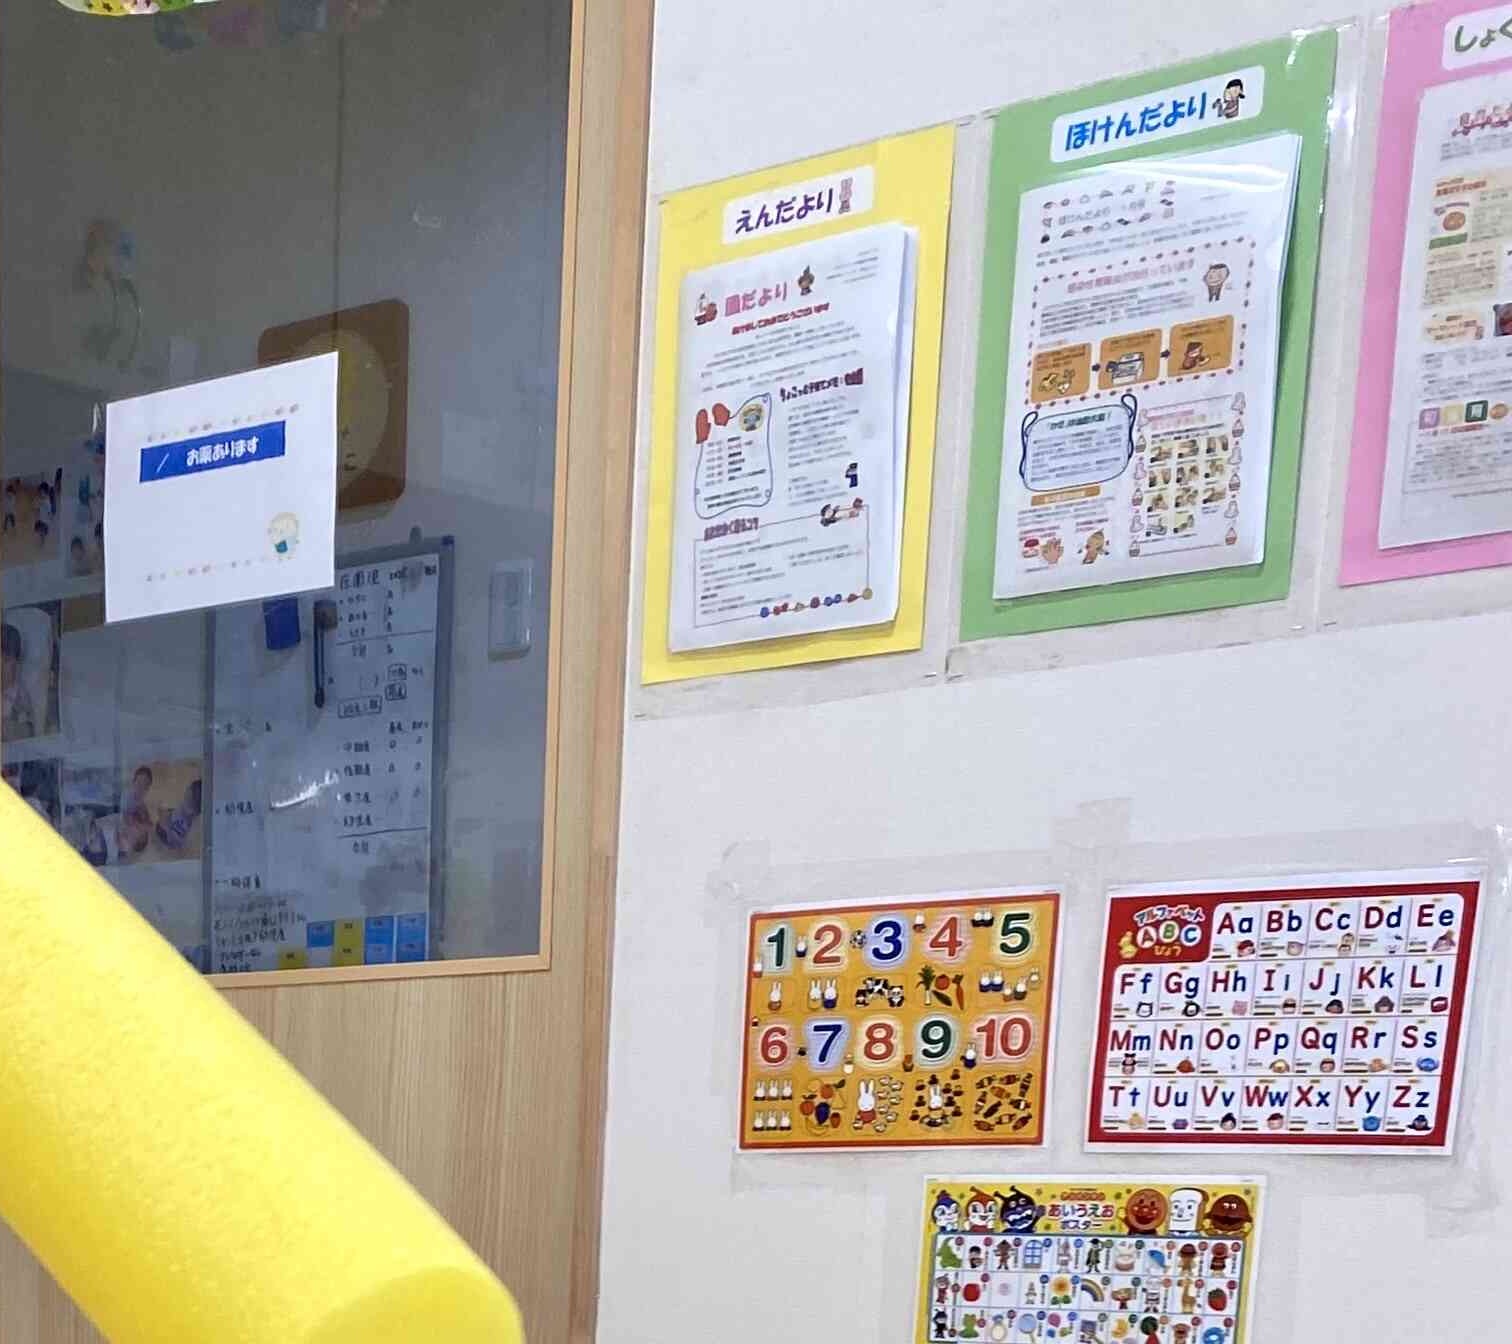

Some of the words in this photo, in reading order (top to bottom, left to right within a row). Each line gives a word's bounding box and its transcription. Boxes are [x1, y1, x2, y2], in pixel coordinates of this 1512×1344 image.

[1064, 91, 1208, 152] ほけんだより
[735, 187, 834, 235] えんだより
[1141, 921, 1198, 946] ABC
[1217, 912, 1253, 935] Aa
[1266, 909, 1302, 932] Bb
[1315, 907, 1351, 930] Cc
[1364, 905, 1402, 928] Dd
[1416, 903, 1454, 928] Ee
[766, 927, 786, 967] 1
[813, 925, 842, 964] 2
[872, 920, 902, 961] 3
[929, 917, 963, 957] 4
[999, 912, 1031, 954] 5
[1120, 973, 1153, 995] Ff
[1164, 972, 1200, 998] Gg
[1211, 970, 1247, 993] Hh
[1263, 969, 1290, 992] Ii
[1308, 968, 1340, 996] Jj
[1357, 966, 1394, 989] Kk
[1410, 965, 1443, 988] Ll
[760, 1026, 788, 1064] 6
[813, 1024, 842, 1063] 7
[863, 1022, 895, 1061] 8
[921, 1019, 952, 1058] 9
[975, 1017, 1032, 1057] 10
[1110, 1029, 1151, 1052] Mm
[1159, 1029, 1193, 1051] Nn
[1205, 1028, 1240, 1050] Oo
[1254, 1027, 1288, 1055] Pp
[1301, 1026, 1337, 1055] Qq
[1351, 1026, 1386, 1049] Rr
[1401, 1025, 1438, 1049] Ss
[1109, 1085, 1140, 1107] Tt
[1154, 1085, 1188, 1107] Uu
[1201, 1085, 1235, 1107] Vv
[1245, 1085, 1288, 1107] Ww
[1295, 1085, 1331, 1107] Xx
[1344, 1085, 1381, 1112] Yy
[1392, 1085, 1430, 1108] Zz
[1048, 1203, 1115, 1218] あいうえお
